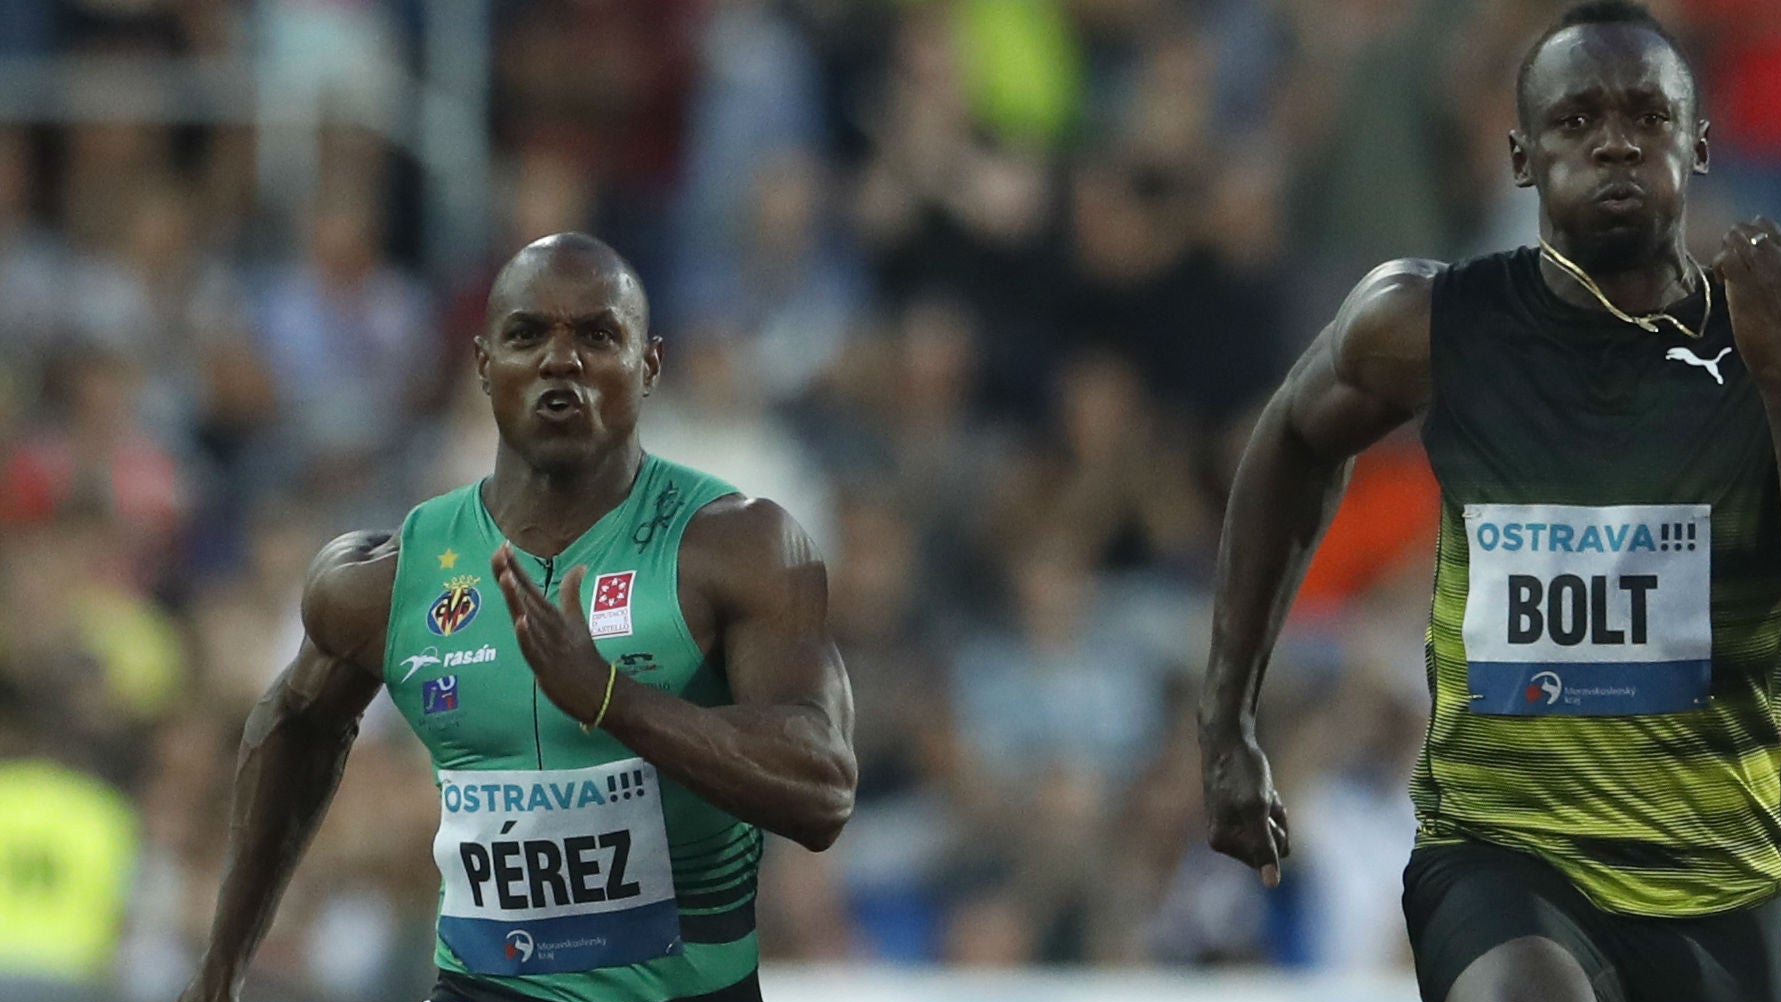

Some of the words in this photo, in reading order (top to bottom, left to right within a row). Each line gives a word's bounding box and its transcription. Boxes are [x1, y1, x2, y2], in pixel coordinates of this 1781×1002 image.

[1477, 522, 1696, 552] OSTRAVA!!!
[1507, 573, 1658, 646] BOLT
[443, 643, 496, 668] rasán
[444, 769, 645, 813] OSTRAVA!!!
[459, 820, 641, 910] PÉREZ
